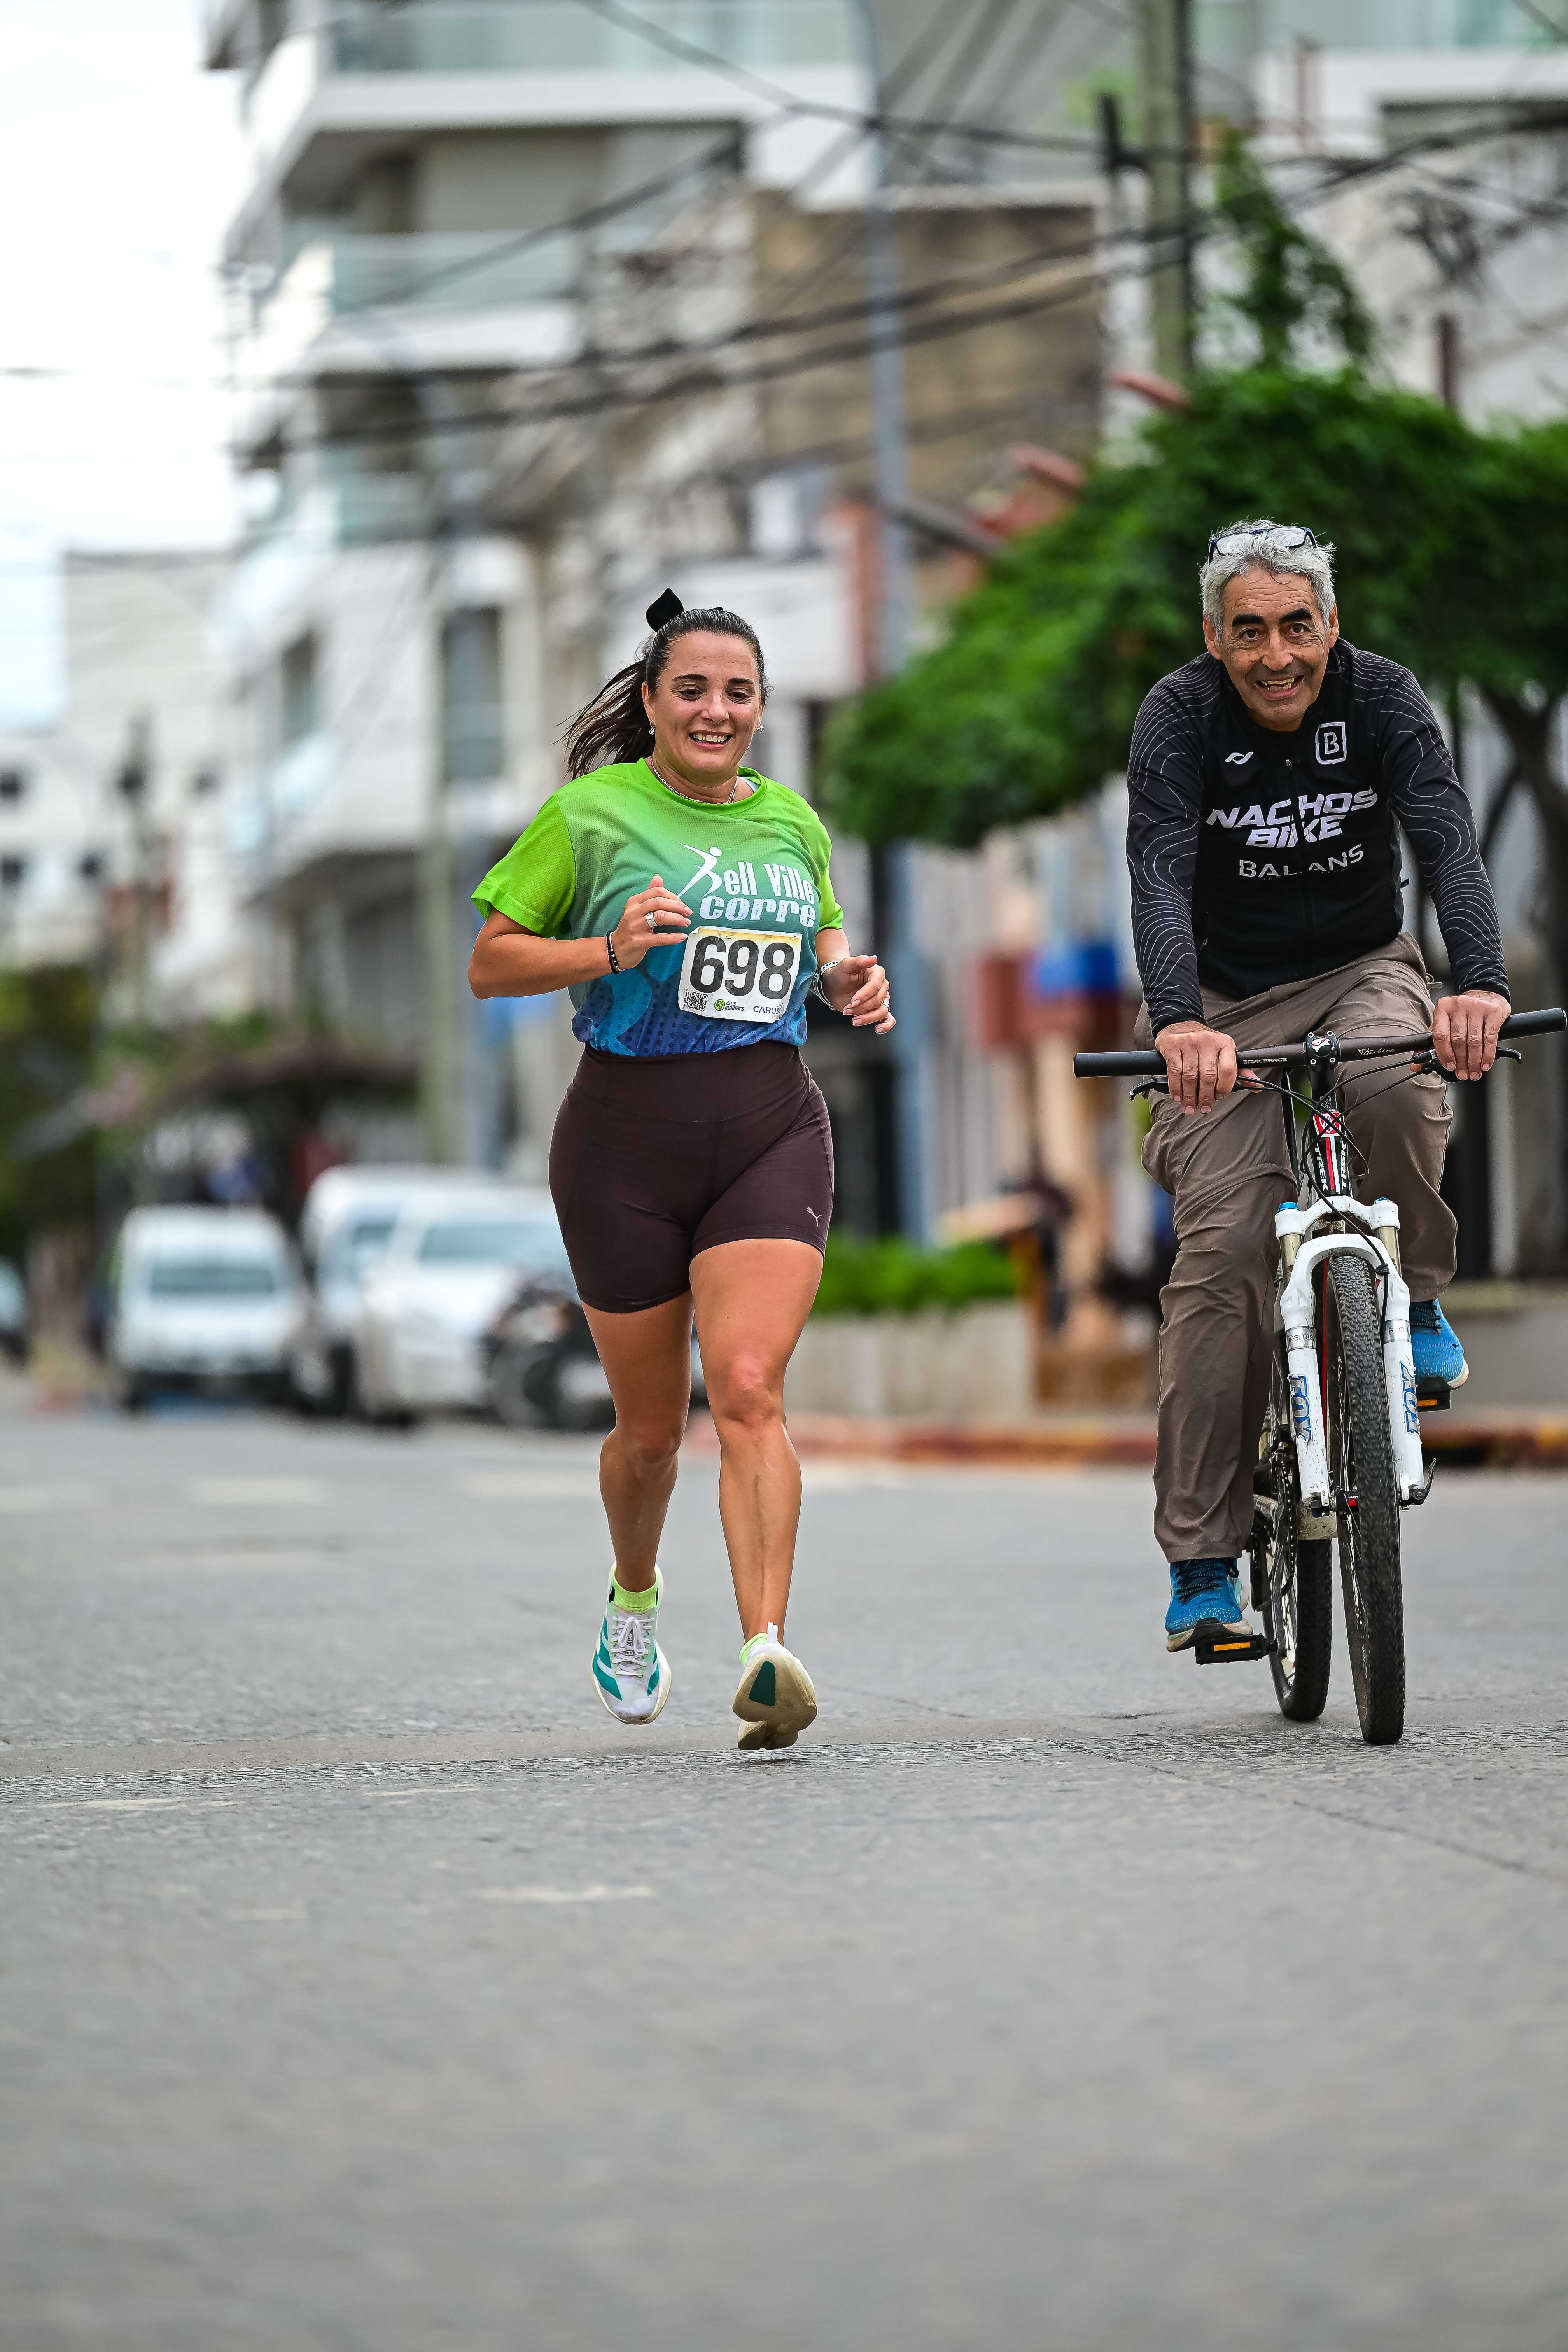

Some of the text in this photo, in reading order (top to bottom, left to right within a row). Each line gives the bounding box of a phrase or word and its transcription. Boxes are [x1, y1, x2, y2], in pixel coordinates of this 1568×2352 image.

[1324, 732, 1339, 754] B
[1206, 786, 1377, 828] NACHOS
[1246, 815, 1346, 848] BIKE
[1239, 844, 1363, 878] BALANS
[763, 863, 815, 905] Ville
[699, 896, 816, 928] corre
[690, 936, 794, 1000] 698
[1314, 1143, 1329, 1192] TREK
[1288, 1374, 1312, 1442] FOX
[1400, 1361, 1420, 1435] FOX
